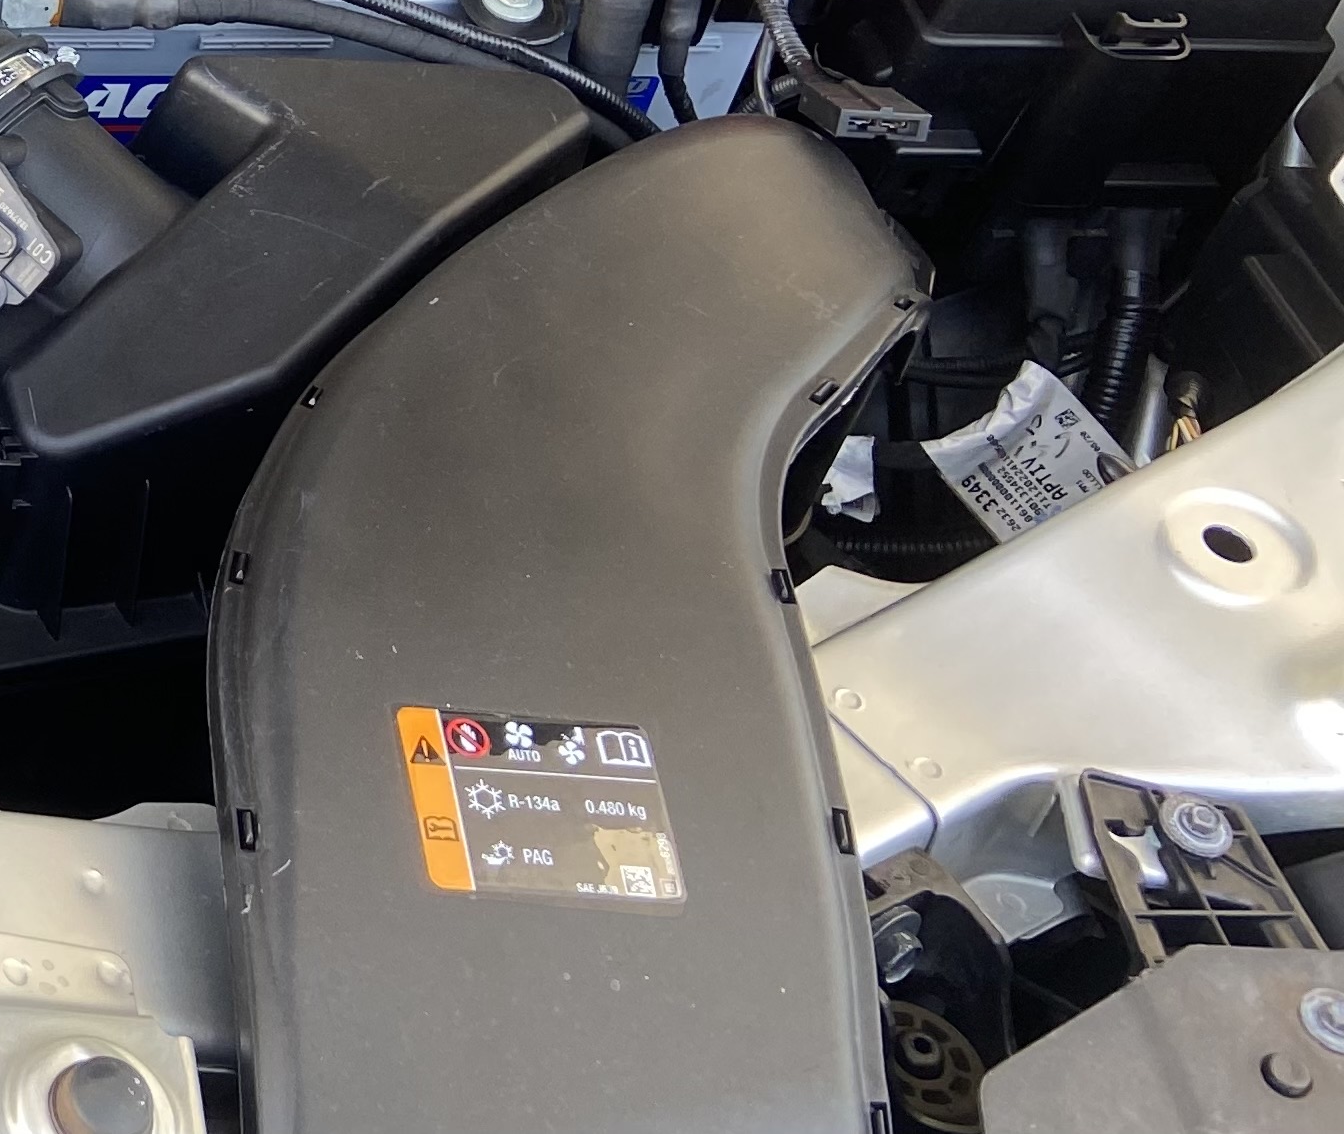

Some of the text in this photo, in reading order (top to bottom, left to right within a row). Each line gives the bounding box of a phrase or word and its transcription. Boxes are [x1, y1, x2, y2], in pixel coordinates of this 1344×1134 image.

[26, 237, 54, 264] C01
[1020, 457, 1069, 501] APTIV
[961, 474, 999, 513] 3349
[507, 748, 542, 763] AUTO
[508, 793, 648, 821] R-134a 0.480 kg
[522, 847, 555, 867] PAG
